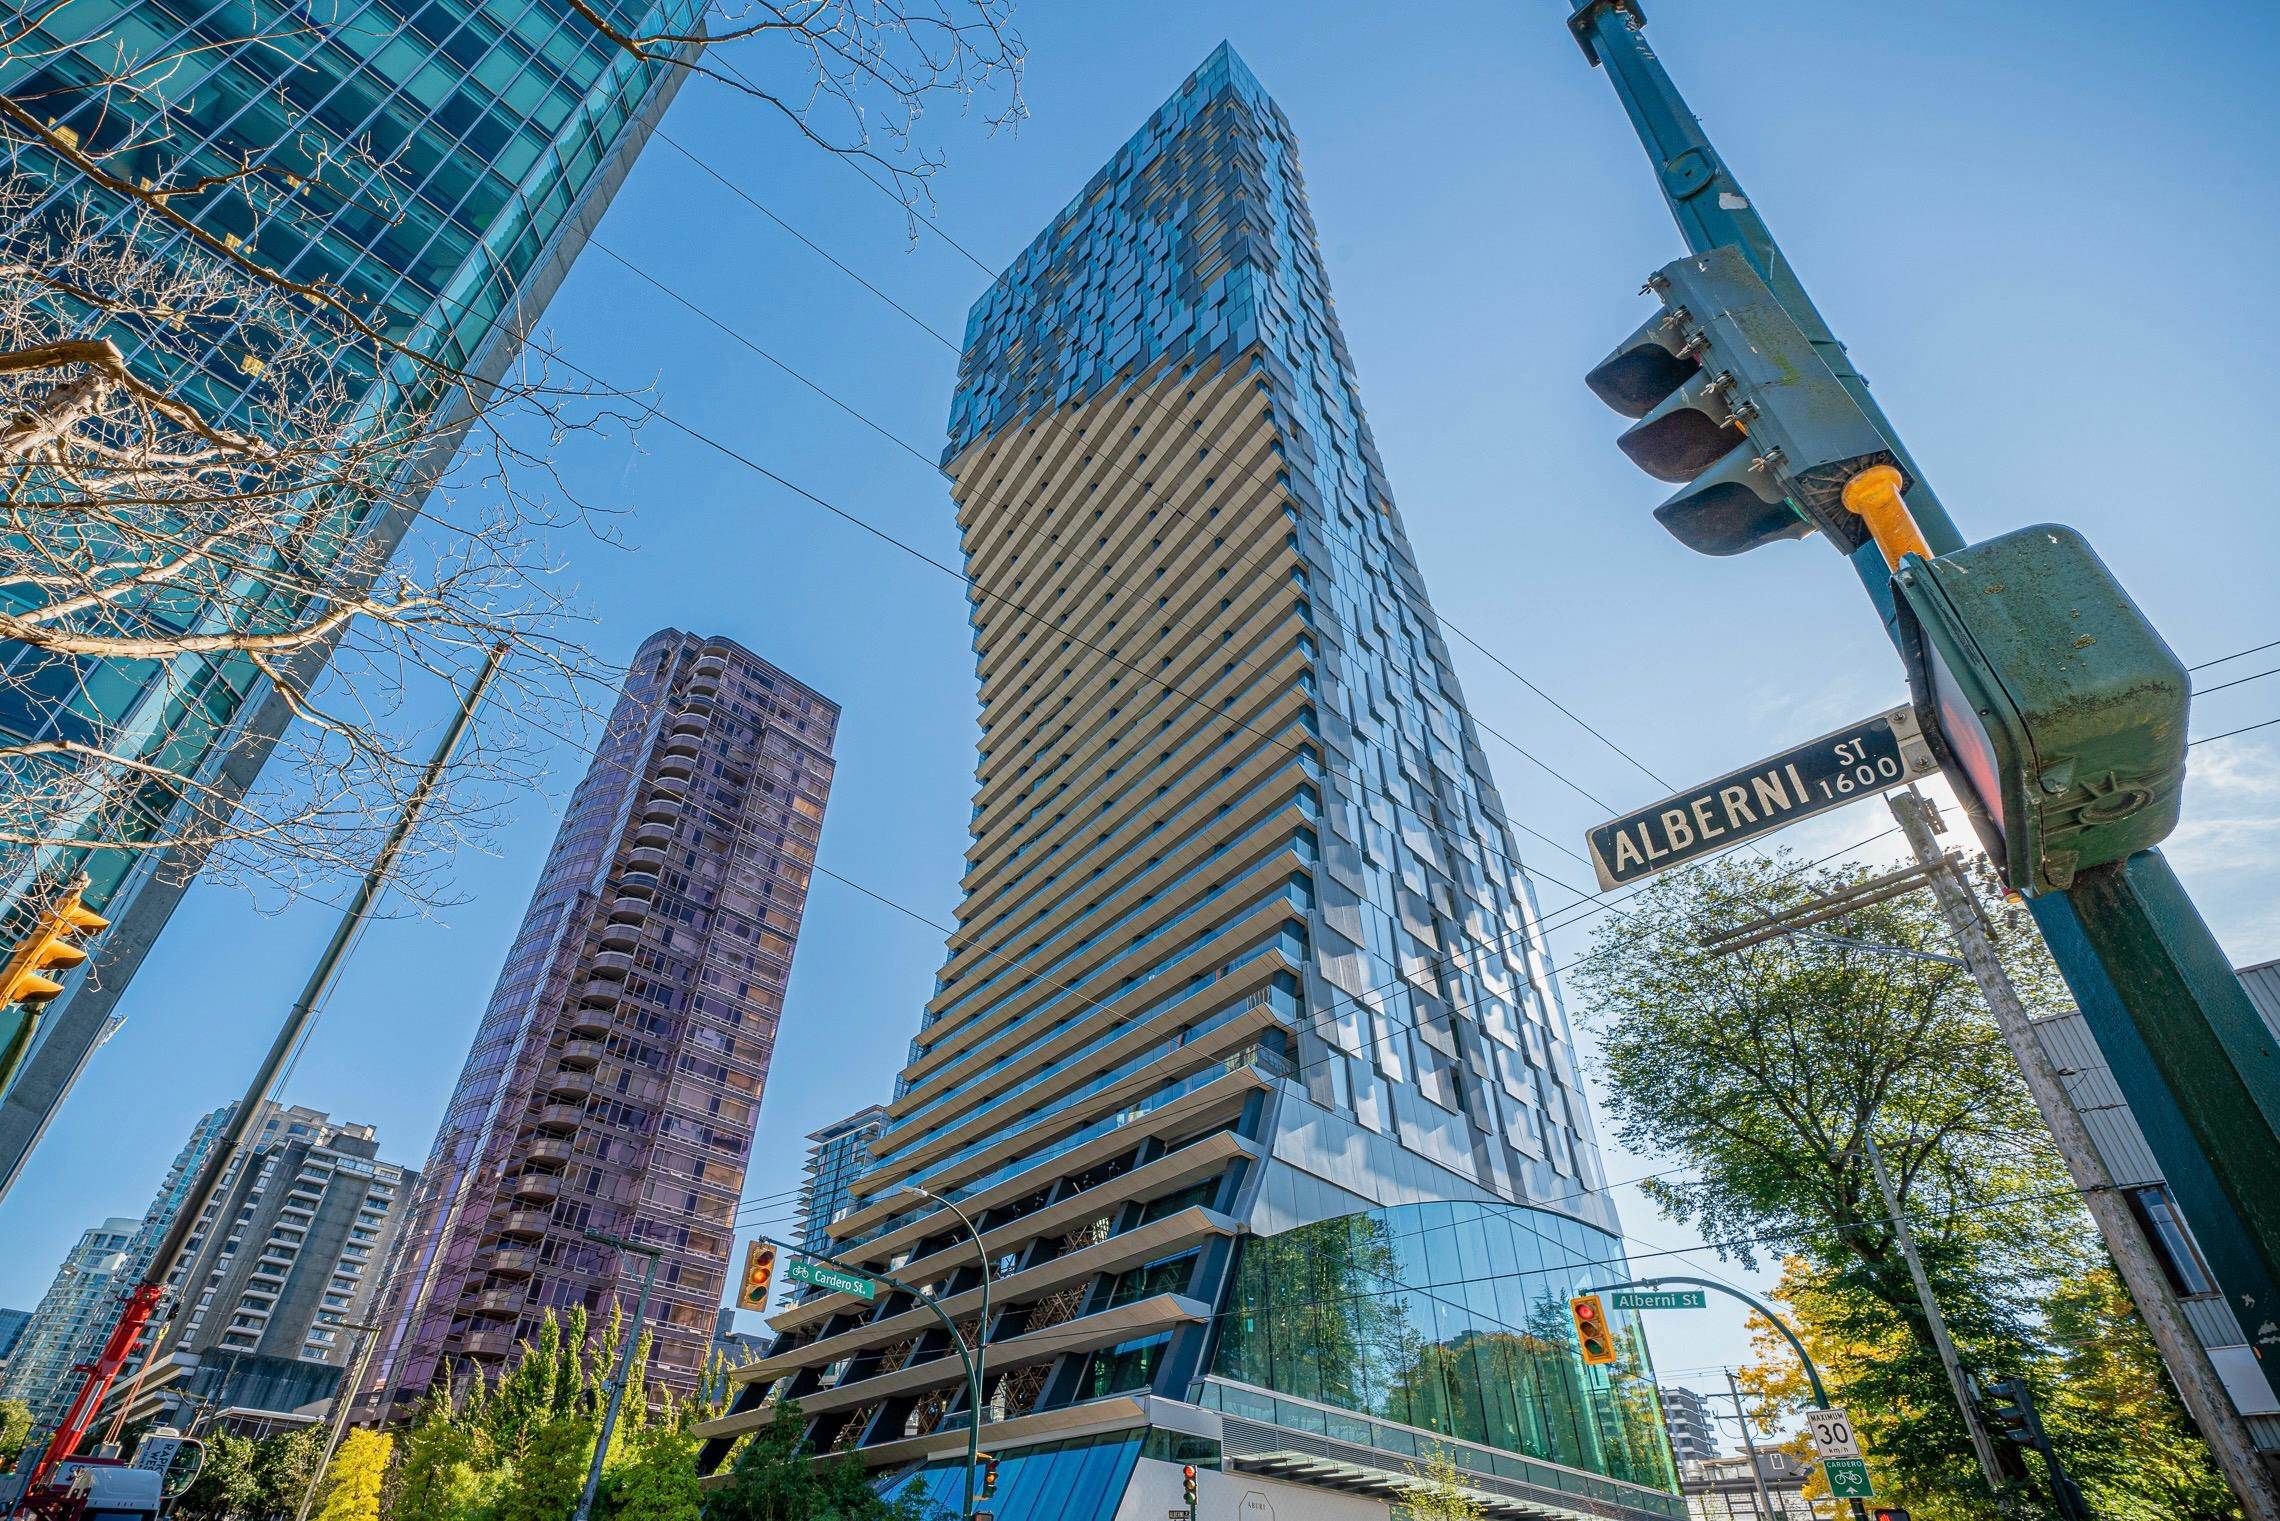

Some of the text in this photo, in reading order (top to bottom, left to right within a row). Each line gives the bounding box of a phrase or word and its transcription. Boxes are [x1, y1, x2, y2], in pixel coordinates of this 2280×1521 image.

[1819, 757, 1898, 799] 1600
[1616, 737, 1867, 873] ALBERNI ST
[815, 1270, 866, 1295] Cardero St.
[1620, 1293, 1699, 1307] Alberni St
[1810, 1412, 1843, 1421] MAXIMUM
[1818, 1423, 1848, 1445] 30
[1826, 1460, 1862, 1468] CARDERO
